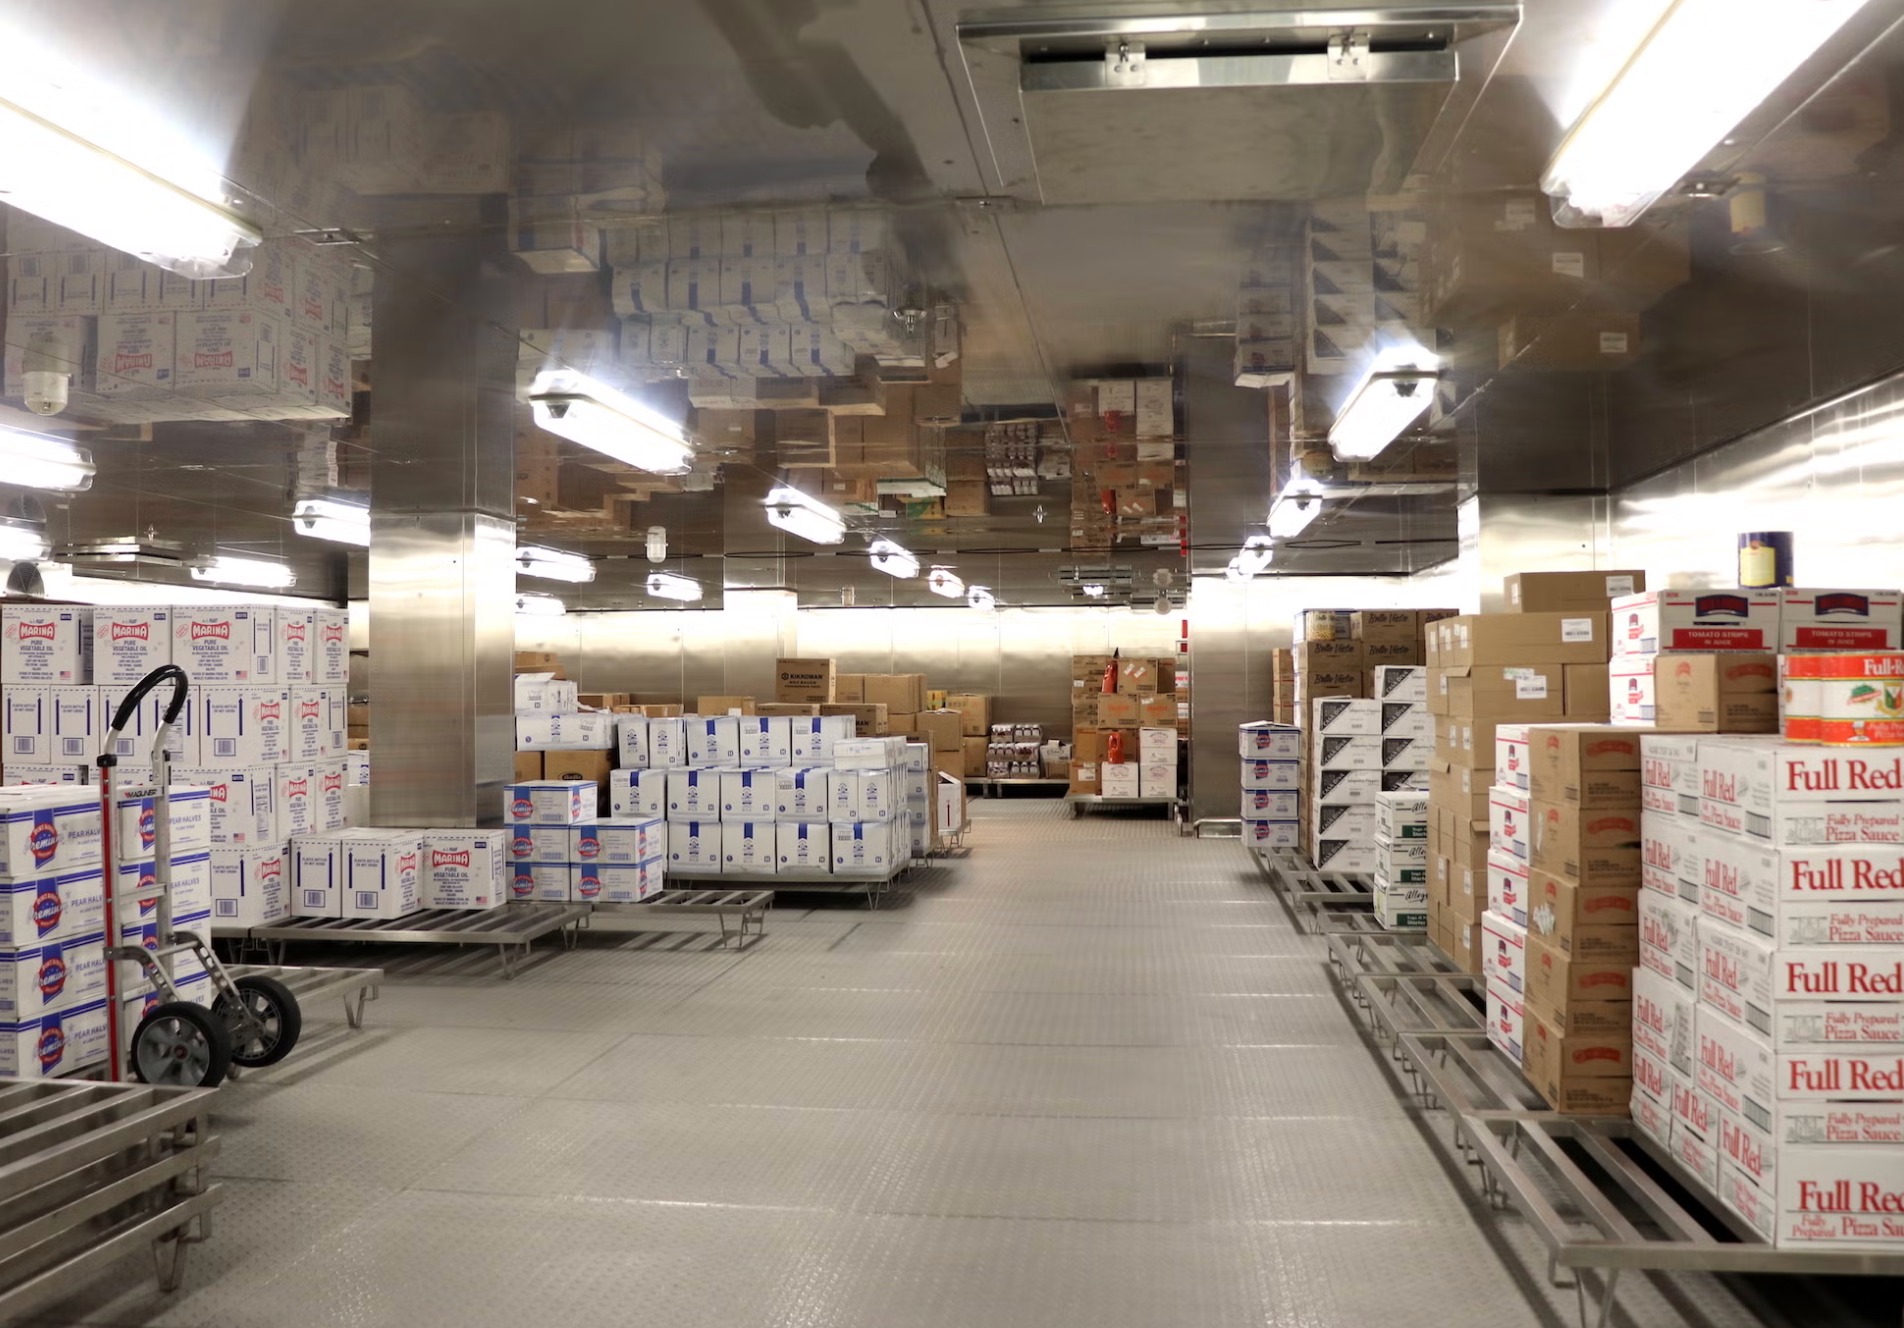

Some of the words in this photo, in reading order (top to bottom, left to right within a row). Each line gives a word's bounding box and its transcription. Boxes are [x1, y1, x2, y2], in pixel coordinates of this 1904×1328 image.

[20, 624, 54, 639] MARINA
[112, 624, 148, 639] MARINA
[192, 623, 229, 639] MARINA
[1645, 760, 1656, 785] Full
[1657, 761, 1671, 788] Red
[1703, 769, 1717, 798] Full
[1718, 772, 1736, 802] Red
[1786, 758, 1840, 791] Full
[1846, 757, 1903, 790] Red
[1827, 814, 1851, 827] Fully
[1853, 814, 1899, 827] Prepared
[68, 830, 86, 839] PEAR
[86, 828, 101, 838] HALV
[1825, 826, 1856, 841] Pizza
[1860, 826, 1900, 841] Sauce
[433, 852, 469, 867] MARINA
[1645, 839, 1656, 865] Full
[1657, 841, 1671, 870] Red
[1705, 858, 1719, 888] Full
[1721, 863, 1738, 895] Red
[1790, 857, 1844, 890] Full
[1851, 856, 1904, 889] Red
[71, 898, 87, 907] PEAR
[87, 895, 102, 904] HALV
[1830, 914, 1855, 927] Fully
[1858, 913, 1903, 927] Prepared
[1643, 916, 1655, 944] Full
[1655, 920, 1669, 951] Red
[1829, 926, 1860, 941] Pizza
[1865, 926, 1904, 941] Sauce
[1705, 947, 1720, 980] Full
[1721, 954, 1738, 989] Red
[1785, 961, 1839, 993] Full
[1846, 961, 1904, 993] Red
[1637, 994, 1649, 1024] Full
[1650, 1002, 1663, 1033] Red
[1826, 1012, 1850, 1024] Fully
[1854, 1012, 1899, 1025] Prepared
[91, 1024, 107, 1034] HALV
[1825, 1024, 1856, 1040] Pizza
[1860, 1025, 1900, 1040] Sauce
[1701, 1035, 1716, 1069] Full
[1718, 1044, 1735, 1081] Red
[1634, 1053, 1647, 1090] Full
[1647, 1063, 1662, 1097] Red
[1788, 1058, 1841, 1091] Full
[1847, 1057, 1904, 1091] Red
[1674, 1083, 1689, 1119] Full
[1691, 1096, 1708, 1133] Red
[1828, 1112, 1852, 1125] Fully
[1855, 1112, 1900, 1125] Prepared
[1826, 1125, 1858, 1140] Pizza
[1862, 1125, 1902, 1140] Sauce
[1722, 1118, 1740, 1160] Full
[1741, 1133, 1762, 1177] Red
[1797, 1179, 1850, 1212] Full
[1841, 1215, 1878, 1236] Pizza
[1882, 1217, 1904, 1236] Sau
